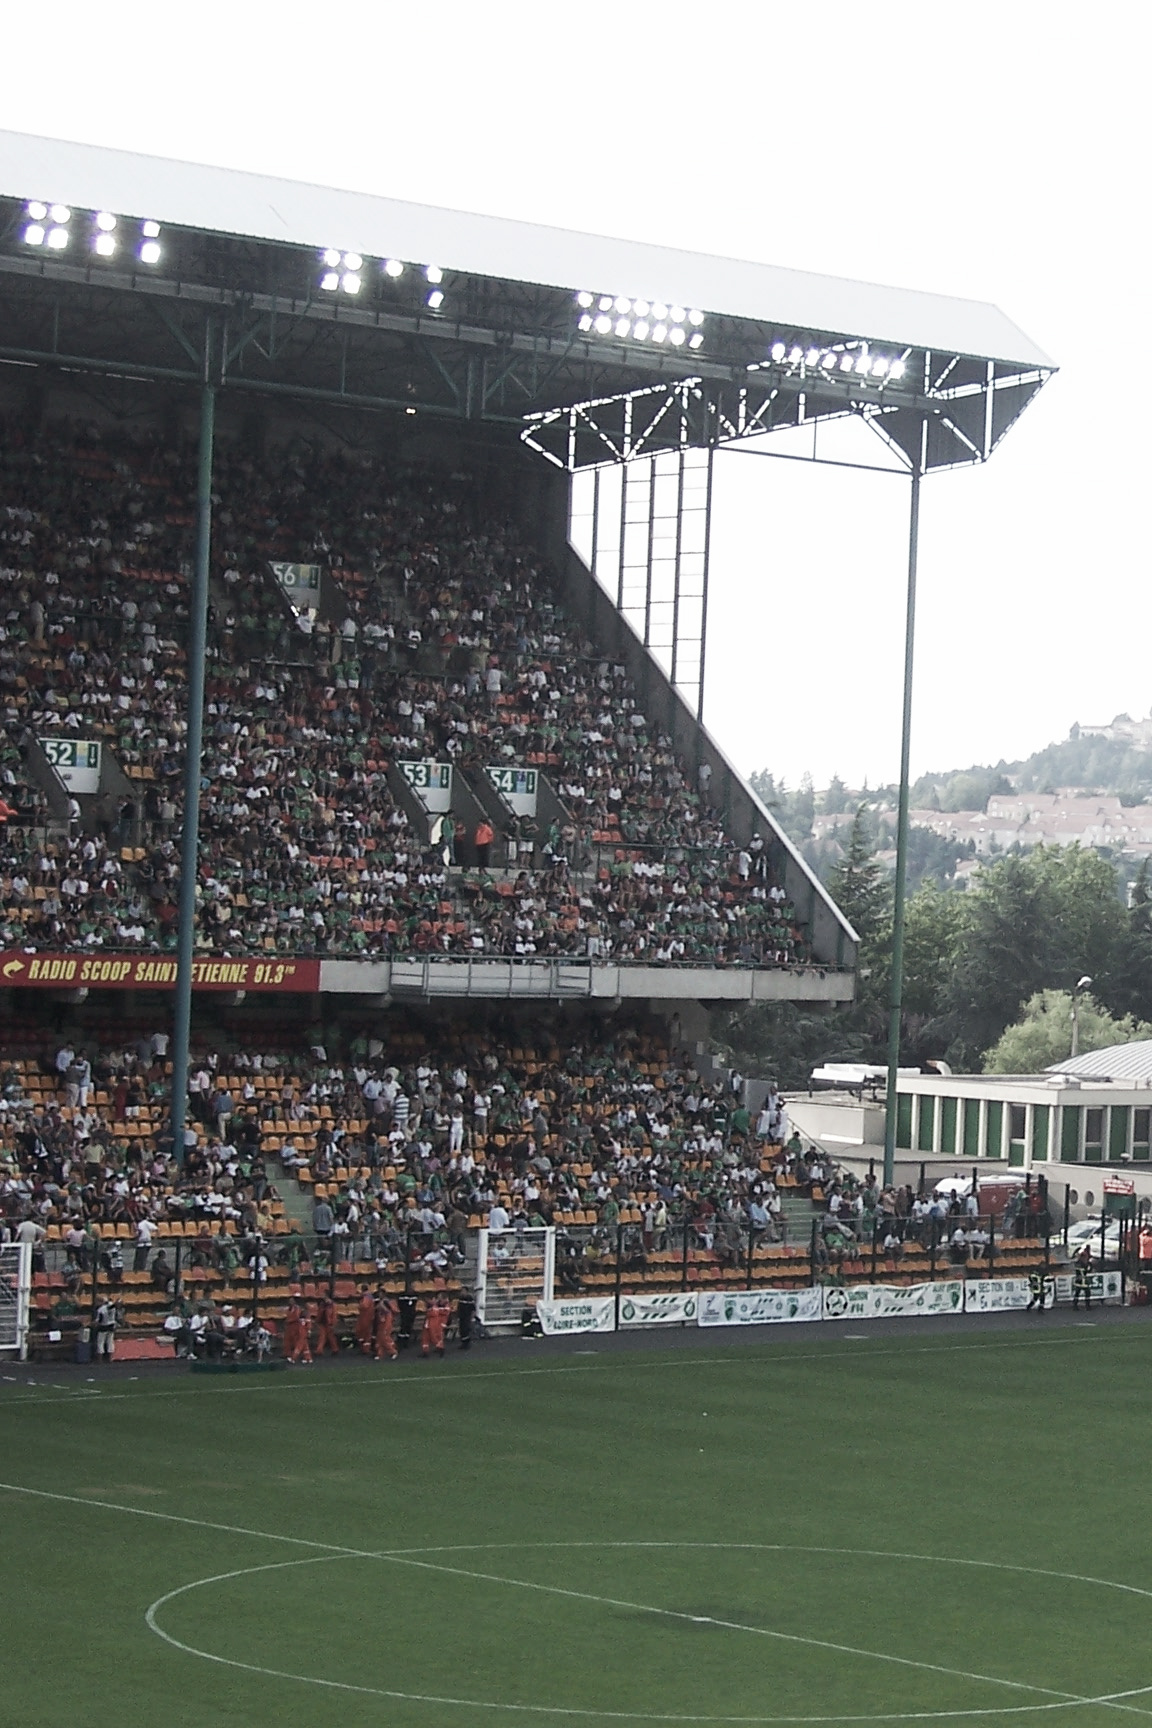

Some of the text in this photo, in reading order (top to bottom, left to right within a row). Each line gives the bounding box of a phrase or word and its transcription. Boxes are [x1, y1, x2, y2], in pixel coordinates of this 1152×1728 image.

[273, 564, 295, 585] 56
[45, 741, 72, 765] 52
[404, 764, 427, 786] 53
[490, 769, 513, 791] 54
[28, 959, 77, 981] RADIO
[80, 960, 131, 982] SCOOP
[560, 1305, 592, 1316] SECTION
